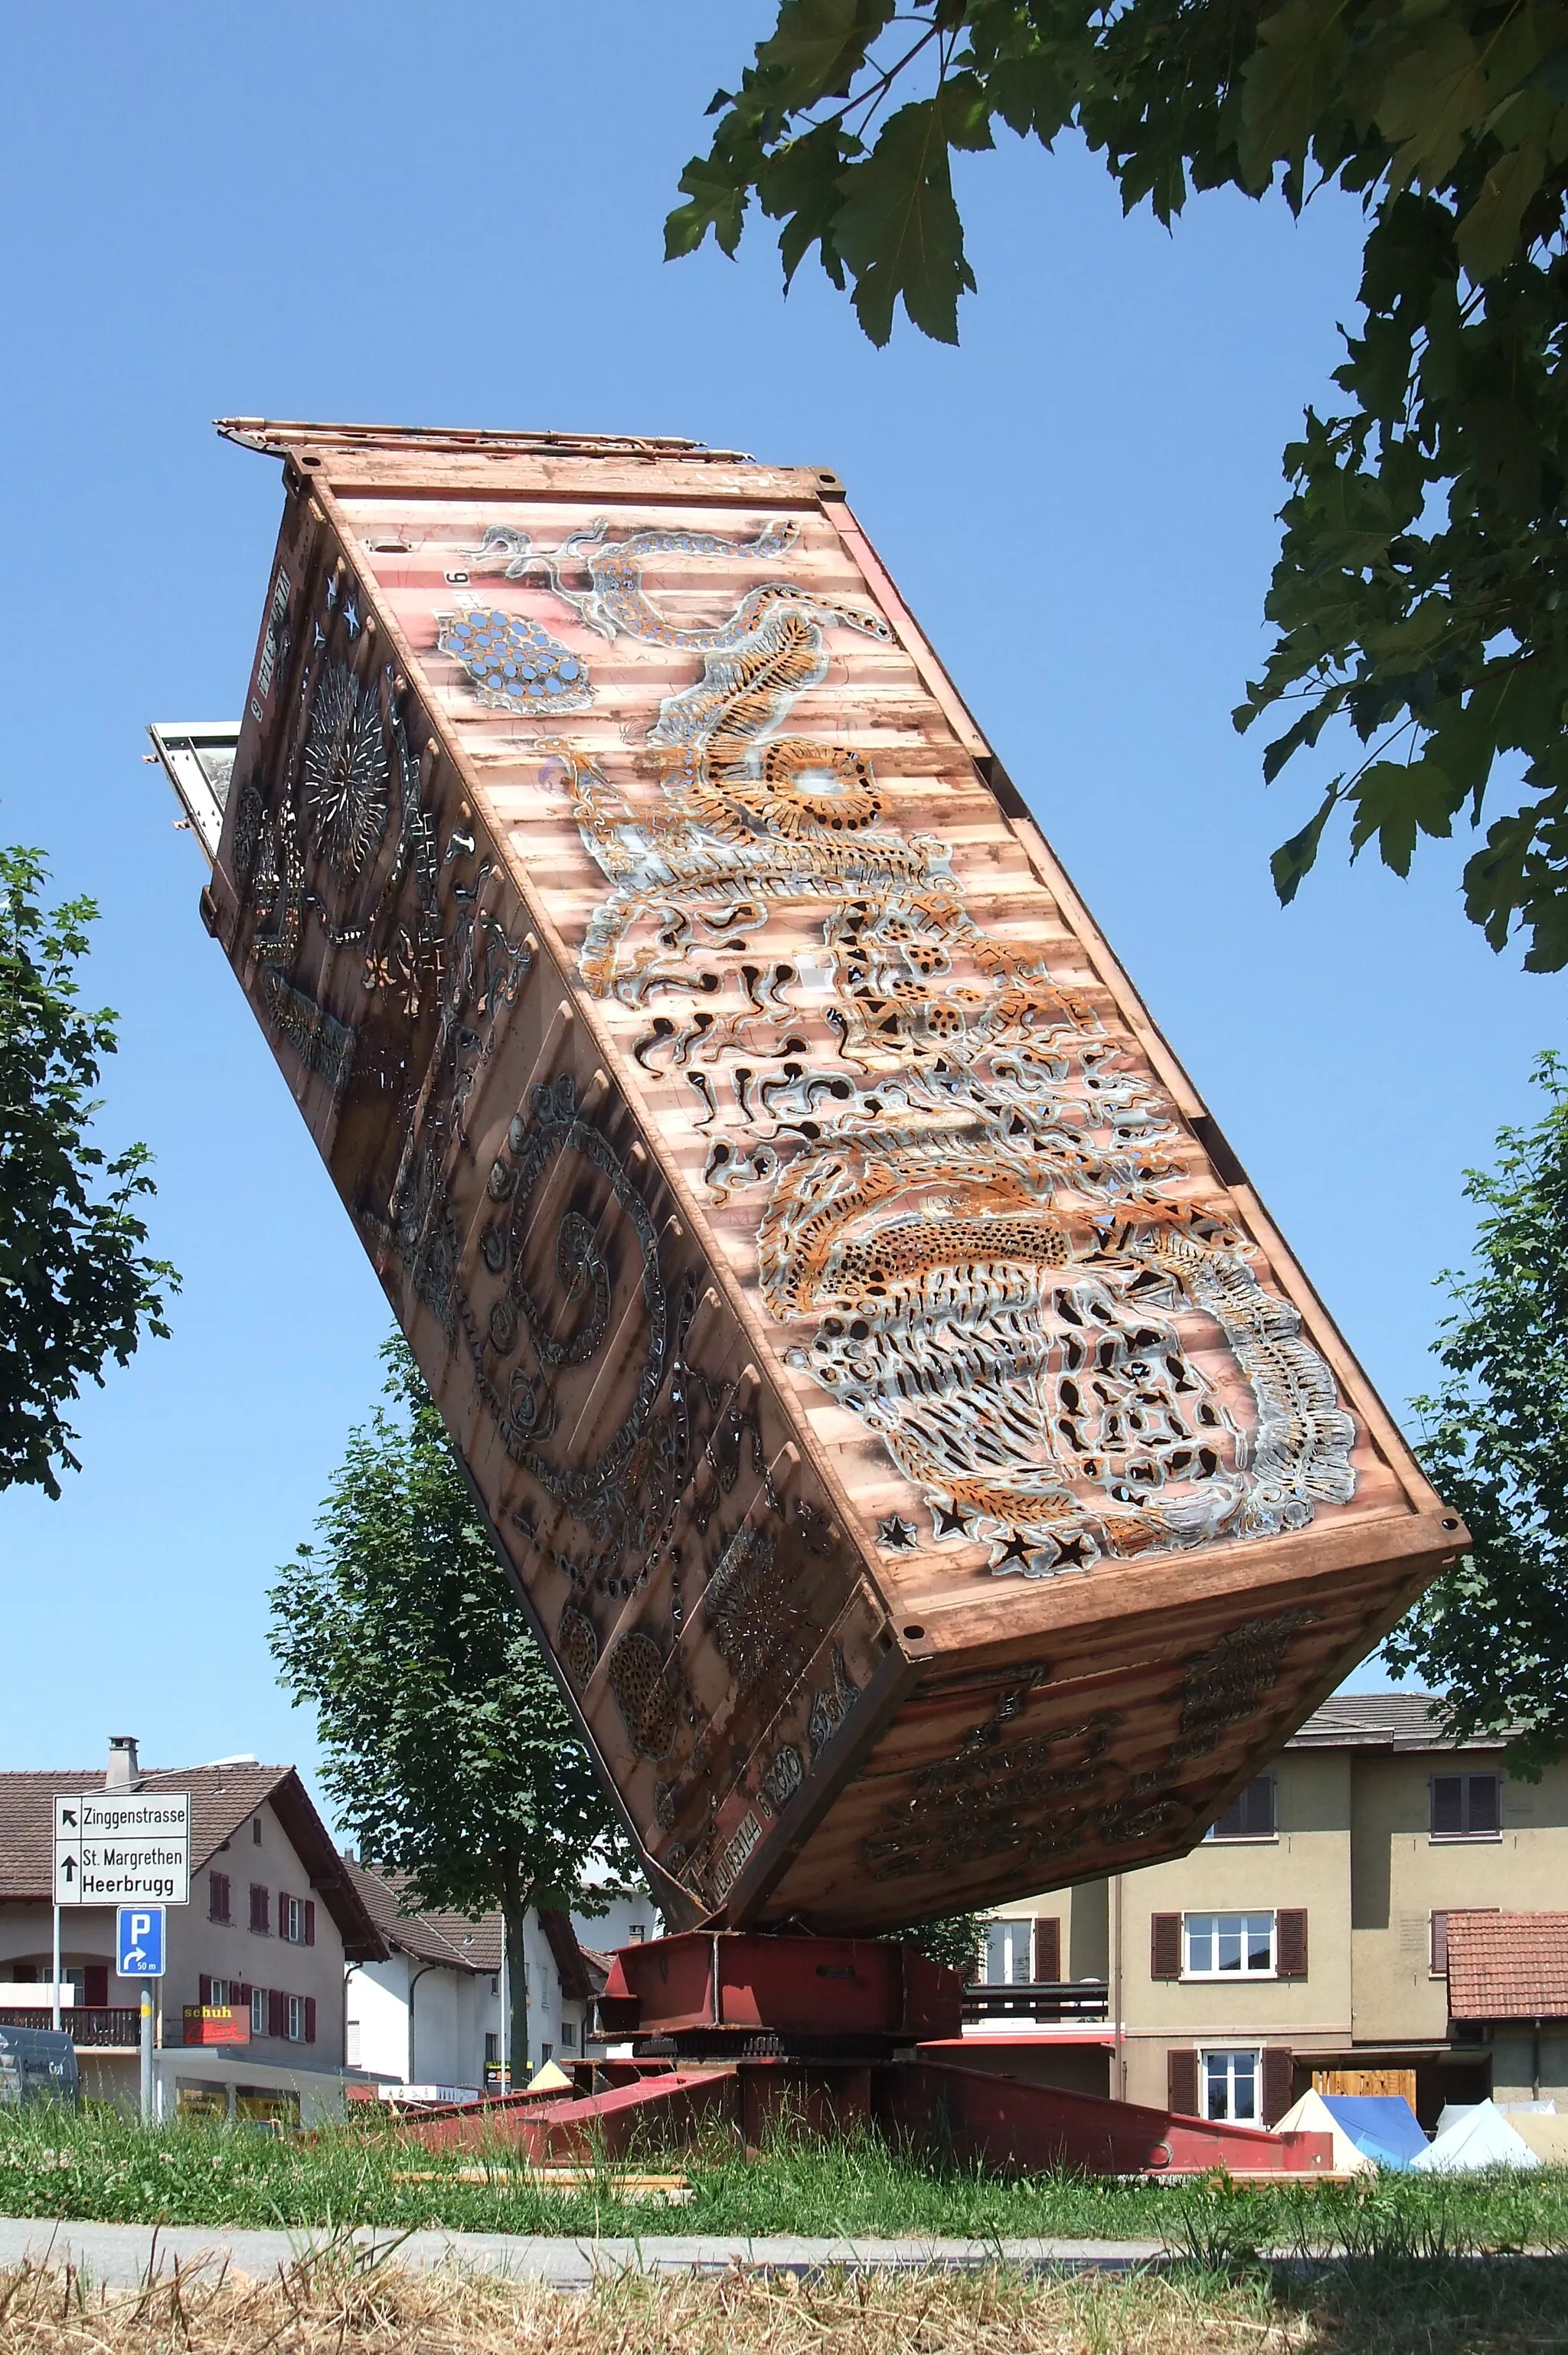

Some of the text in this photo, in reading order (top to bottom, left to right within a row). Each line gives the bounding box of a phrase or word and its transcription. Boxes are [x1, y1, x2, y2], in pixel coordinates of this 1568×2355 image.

[83, 1807, 185, 1830] Zinggenstrasse
[83, 1847, 182, 1870] St. Margrethen
[83, 1874, 174, 1896] Heerbrugg
[131, 1913, 152, 1945] P
[137, 1961, 147, 1971] 50
[184, 2006, 233, 2018] schuh
